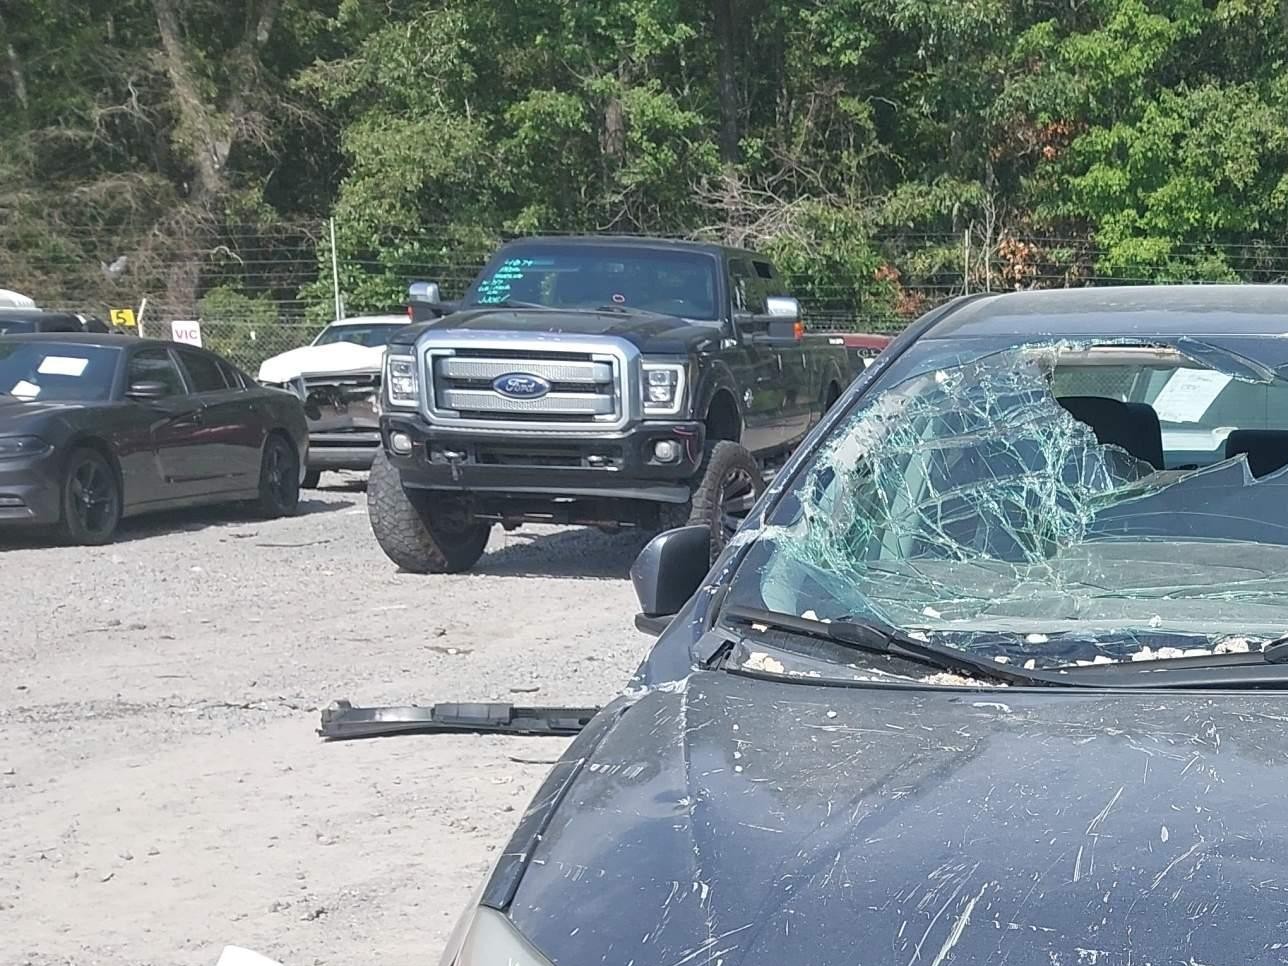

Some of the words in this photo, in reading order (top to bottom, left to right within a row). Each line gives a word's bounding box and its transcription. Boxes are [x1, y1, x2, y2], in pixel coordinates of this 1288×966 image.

[115, 311, 127, 325] 5
[174, 329, 199, 340] VIC
[505, 378, 536, 393] Ford
